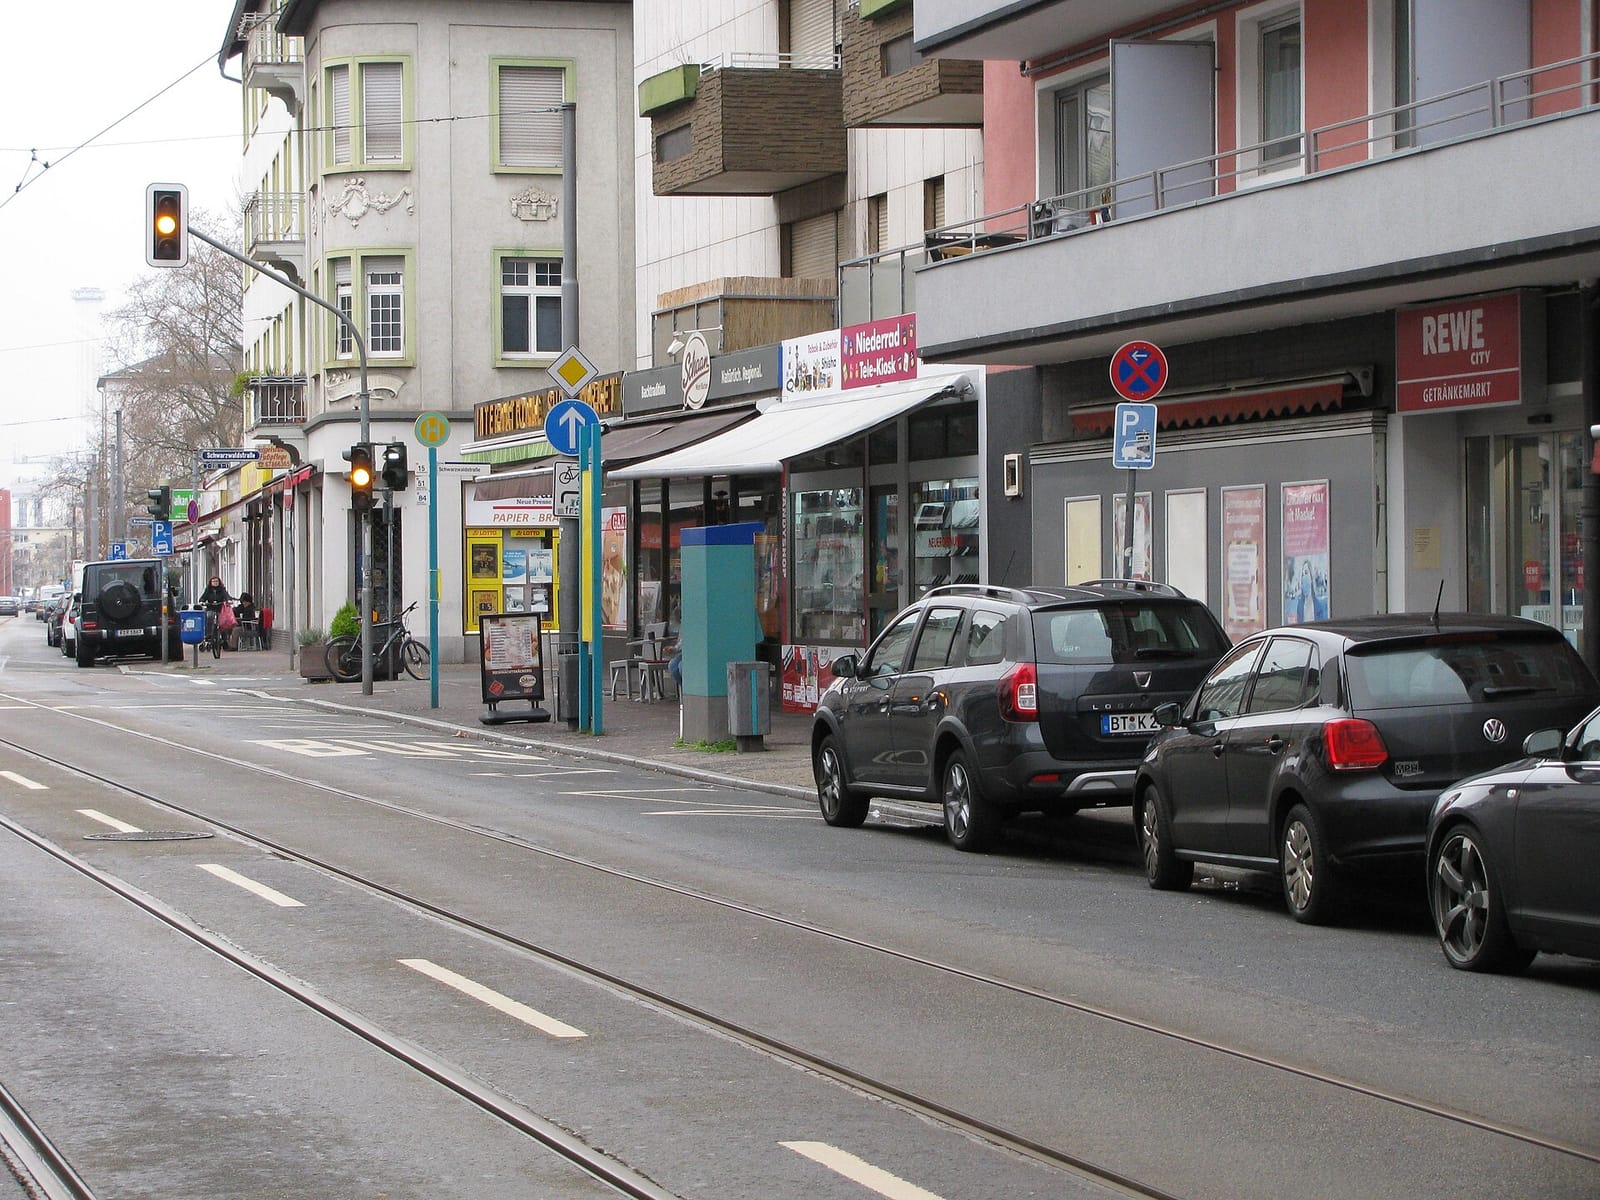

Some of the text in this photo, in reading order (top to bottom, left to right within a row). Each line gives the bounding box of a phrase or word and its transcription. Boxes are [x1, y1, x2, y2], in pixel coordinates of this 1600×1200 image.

[855, 323, 900, 354] Niederrad
[1422, 308, 1485, 356] REWE
[807, 344, 819, 354] Tabak
[1470, 350, 1491, 365] CITY
[821, 357, 837, 369] Shisha
[859, 355, 896, 379] Tele-Kiosk
[721, 363, 763, 384] Natürlich. Regional.
[641, 381, 666, 399] Backtradition
[1423, 382, 1491, 403] GETRÄNKEMARKT
[426, 420, 440, 441] H
[1121, 410, 1140, 436] P
[206, 450, 256, 460] Schwarzwaldstraße
[493, 513, 529, 523] PAPIER
[538, 513, 560, 522] BRA
[155, 523, 164, 537] P
[114, 545, 120, 555] P
[1111, 715, 1128, 731] BT
[1137, 715, 1147, 729] K
